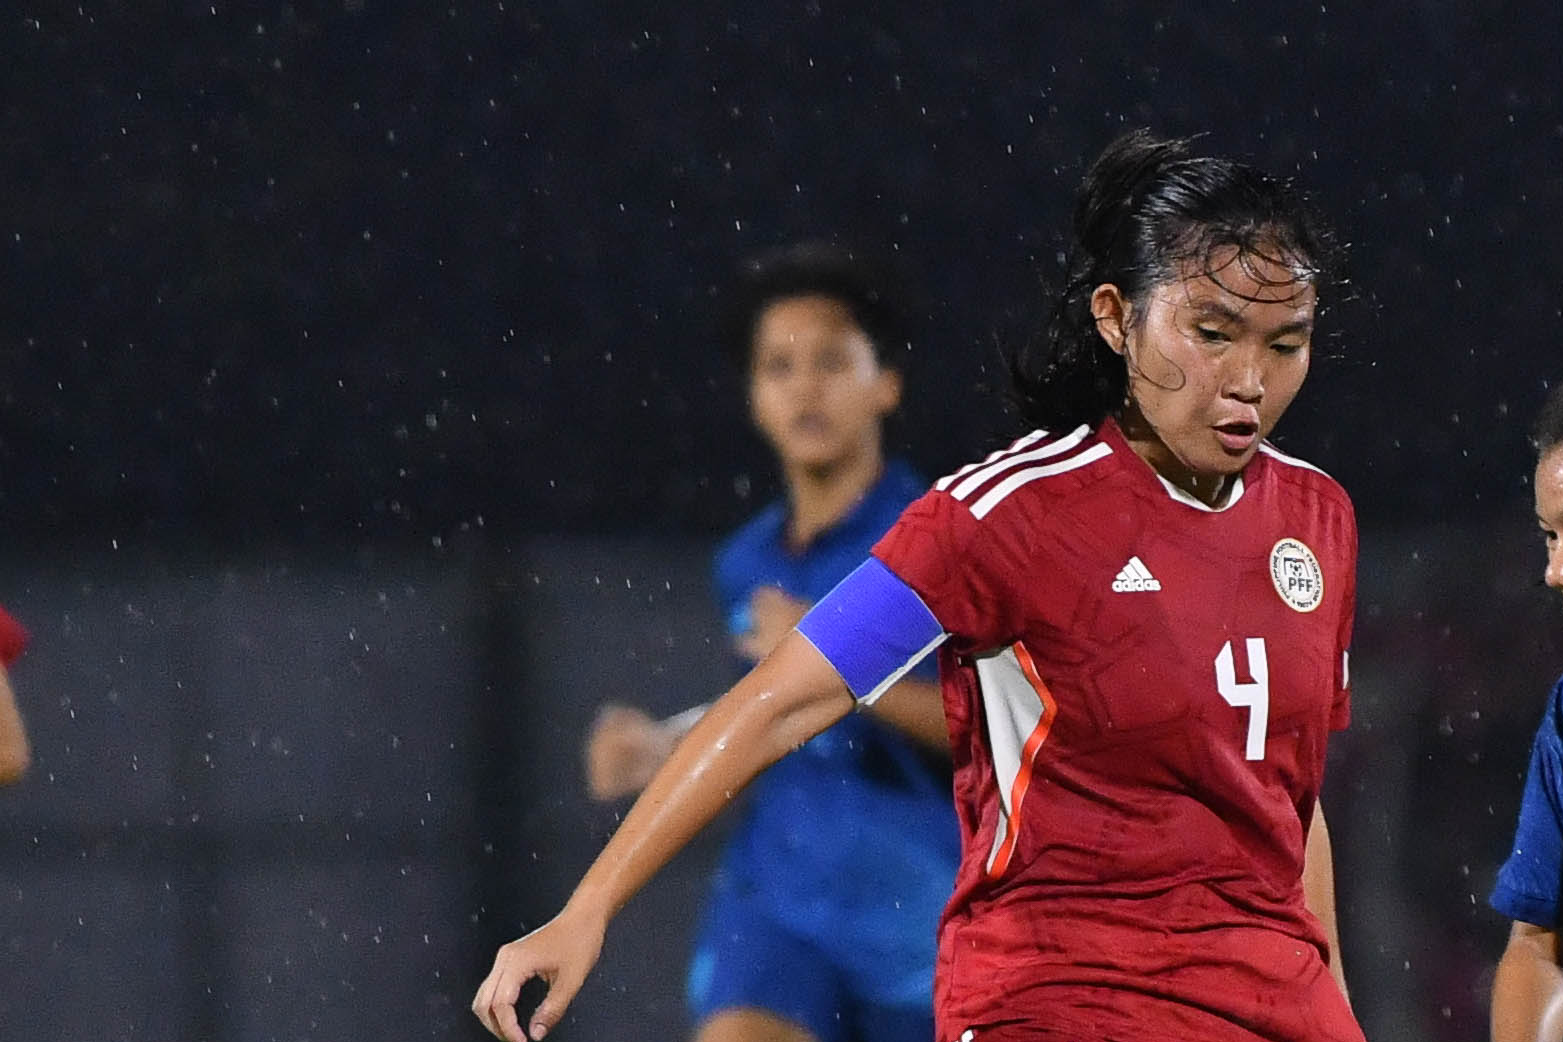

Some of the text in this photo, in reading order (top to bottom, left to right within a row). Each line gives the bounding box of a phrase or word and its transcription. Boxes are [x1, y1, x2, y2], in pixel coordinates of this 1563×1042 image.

[1111, 578, 1162, 592] adidas
[1288, 576, 1314, 593] PFF
[1214, 637, 1269, 761] 4
